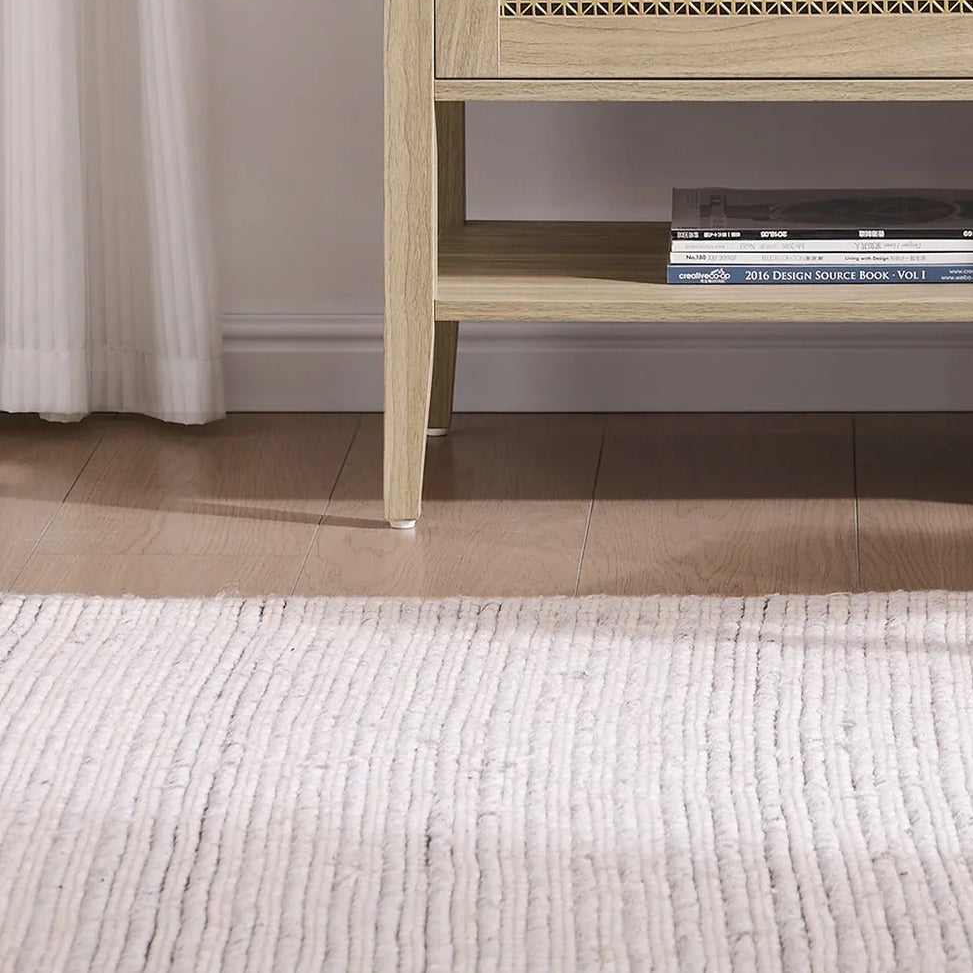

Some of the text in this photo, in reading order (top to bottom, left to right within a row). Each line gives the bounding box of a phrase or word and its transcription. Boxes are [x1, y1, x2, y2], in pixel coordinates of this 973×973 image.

[873, 255, 889, 263] Design
[745, 270, 770, 281] 2016
[773, 270, 812, 281] DESIGN
[815, 270, 857, 281] SOURCE
[860, 270, 890, 280] BOOK
[896, 270, 919, 280] VOL
